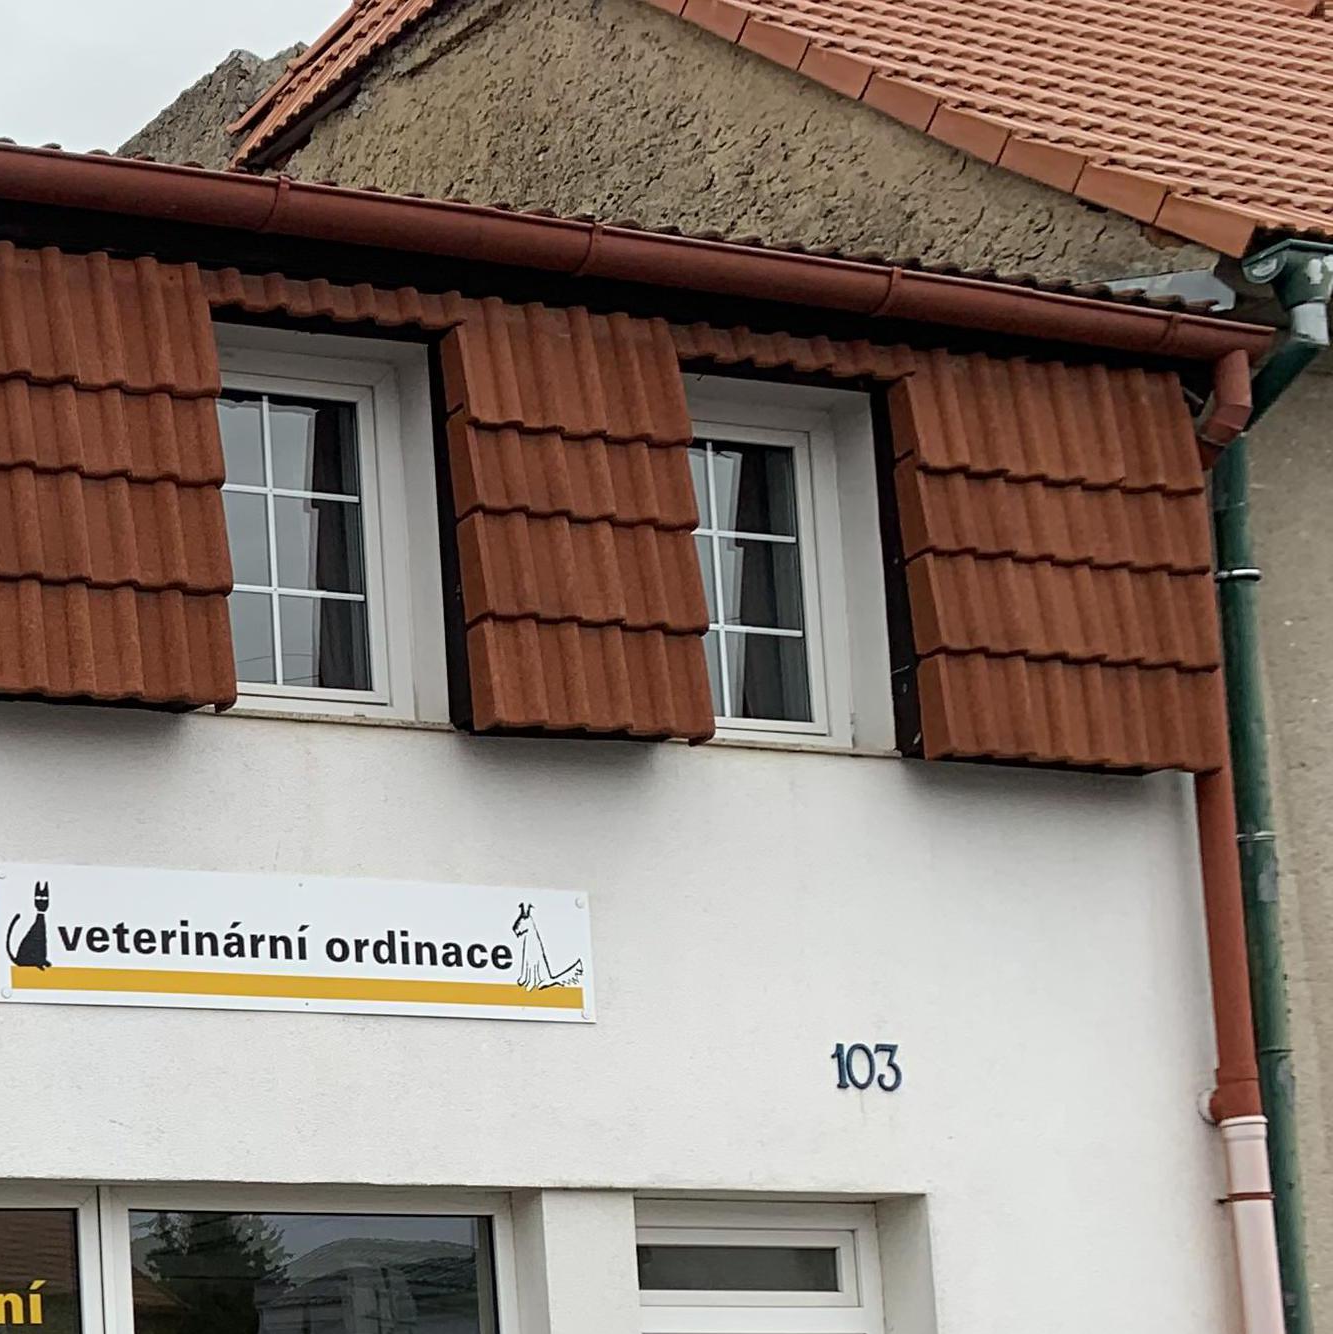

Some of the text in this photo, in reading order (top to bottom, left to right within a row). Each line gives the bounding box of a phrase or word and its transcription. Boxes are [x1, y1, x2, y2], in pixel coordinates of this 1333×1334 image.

[57, 920, 515, 970] veterinární ordinace
[830, 1042, 903, 1092] 103
